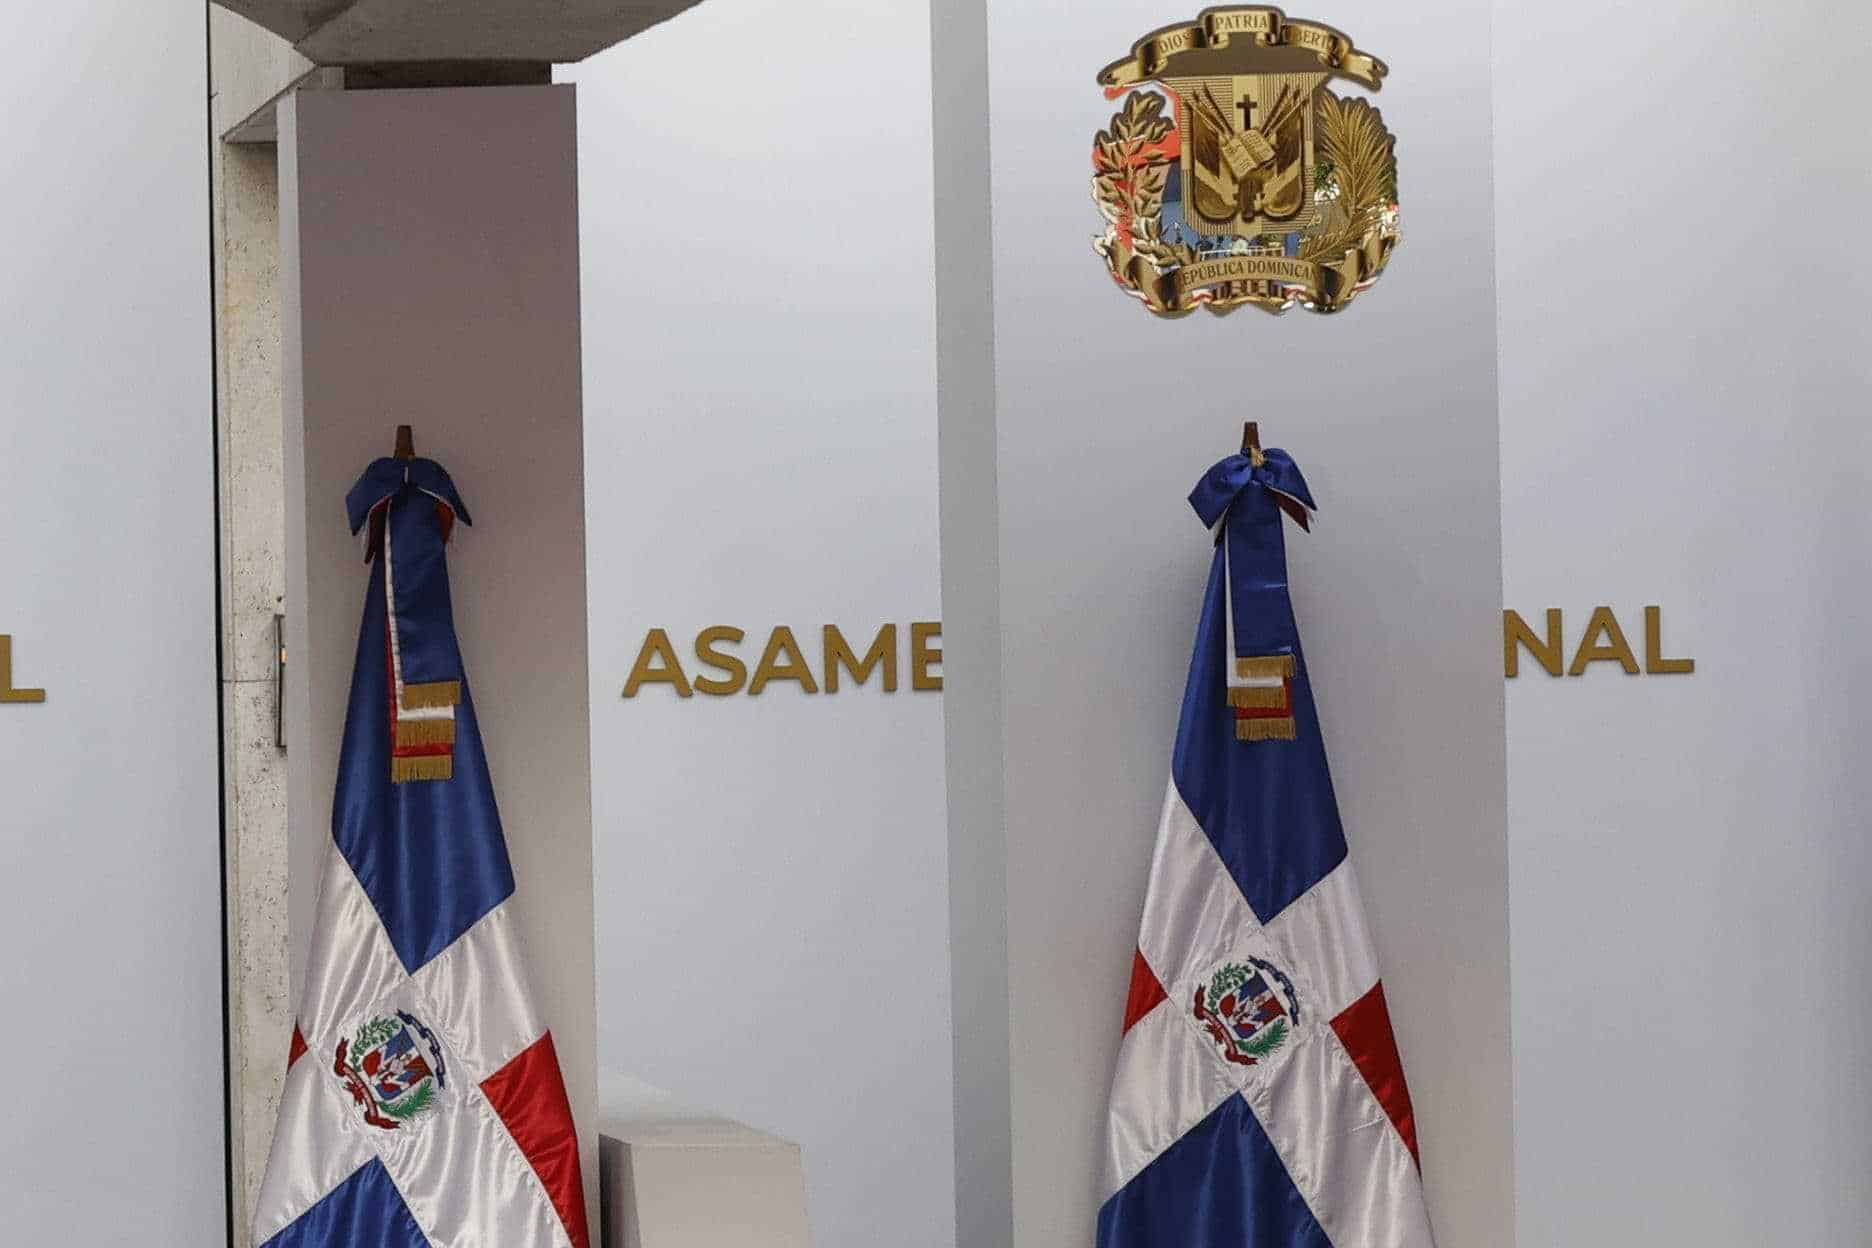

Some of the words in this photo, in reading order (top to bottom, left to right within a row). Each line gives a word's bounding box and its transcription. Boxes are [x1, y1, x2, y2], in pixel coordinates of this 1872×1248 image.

[1215, 13, 1268, 30] PATRIA
[1183, 261, 1244, 286] EPÚBLICA
[1502, 607, 1696, 678] NAL
